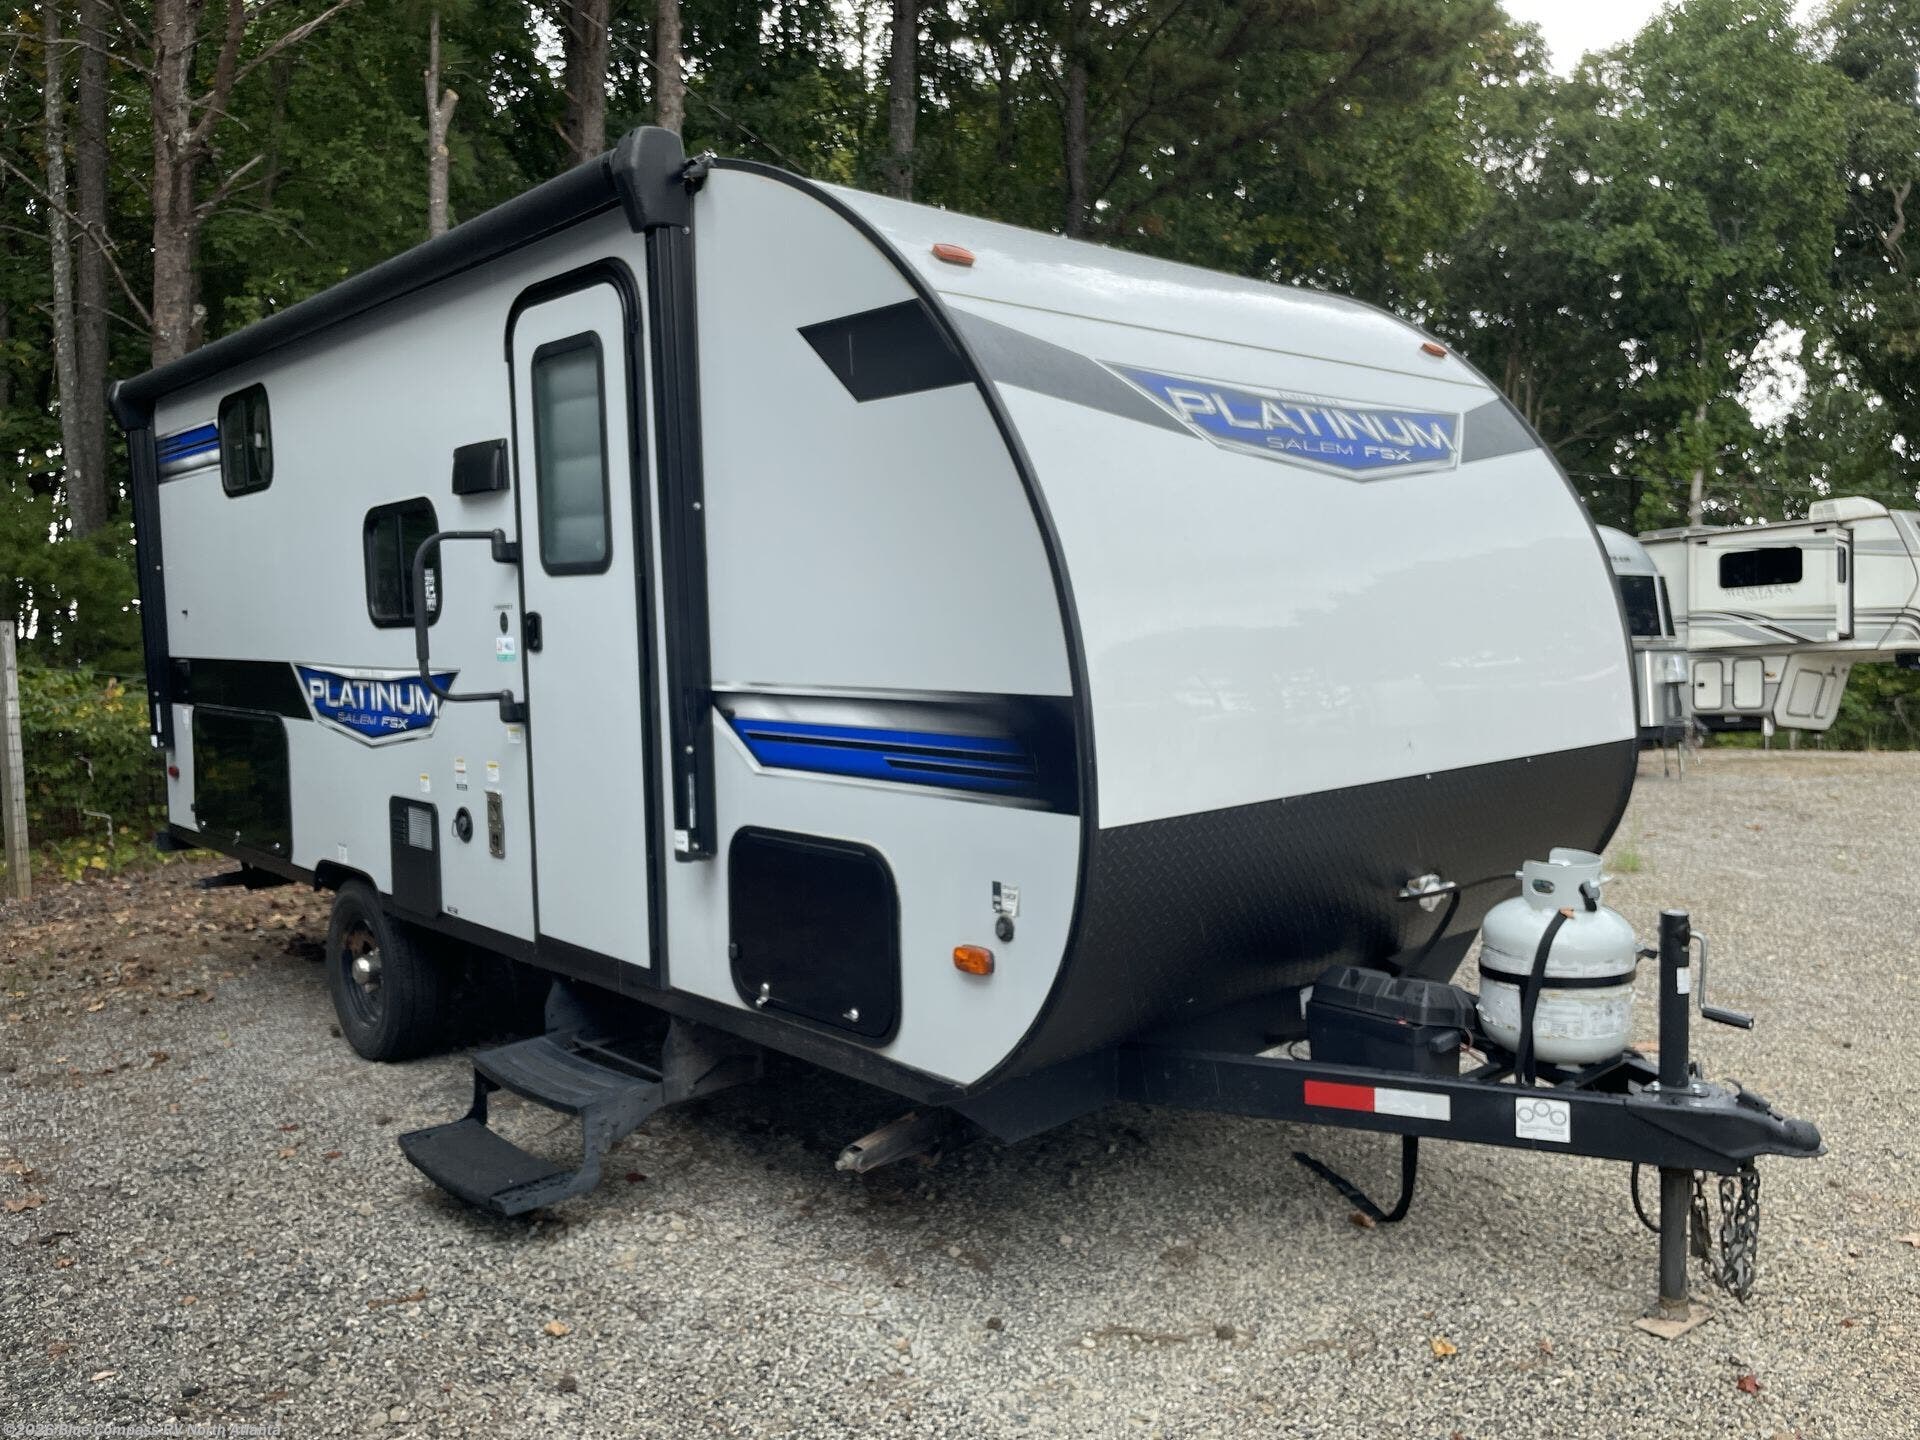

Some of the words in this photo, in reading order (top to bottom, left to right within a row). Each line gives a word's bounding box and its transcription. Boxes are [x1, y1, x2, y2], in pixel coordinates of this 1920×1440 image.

[1165, 386, 1459, 454] PLATINUM
[1266, 436, 1354, 457] SALEM
[1364, 446, 1412, 463] FSX
[309, 677, 440, 717] PLATINUM
[337, 711, 377, 726] SALEM
[381, 716, 409, 730] FSX
